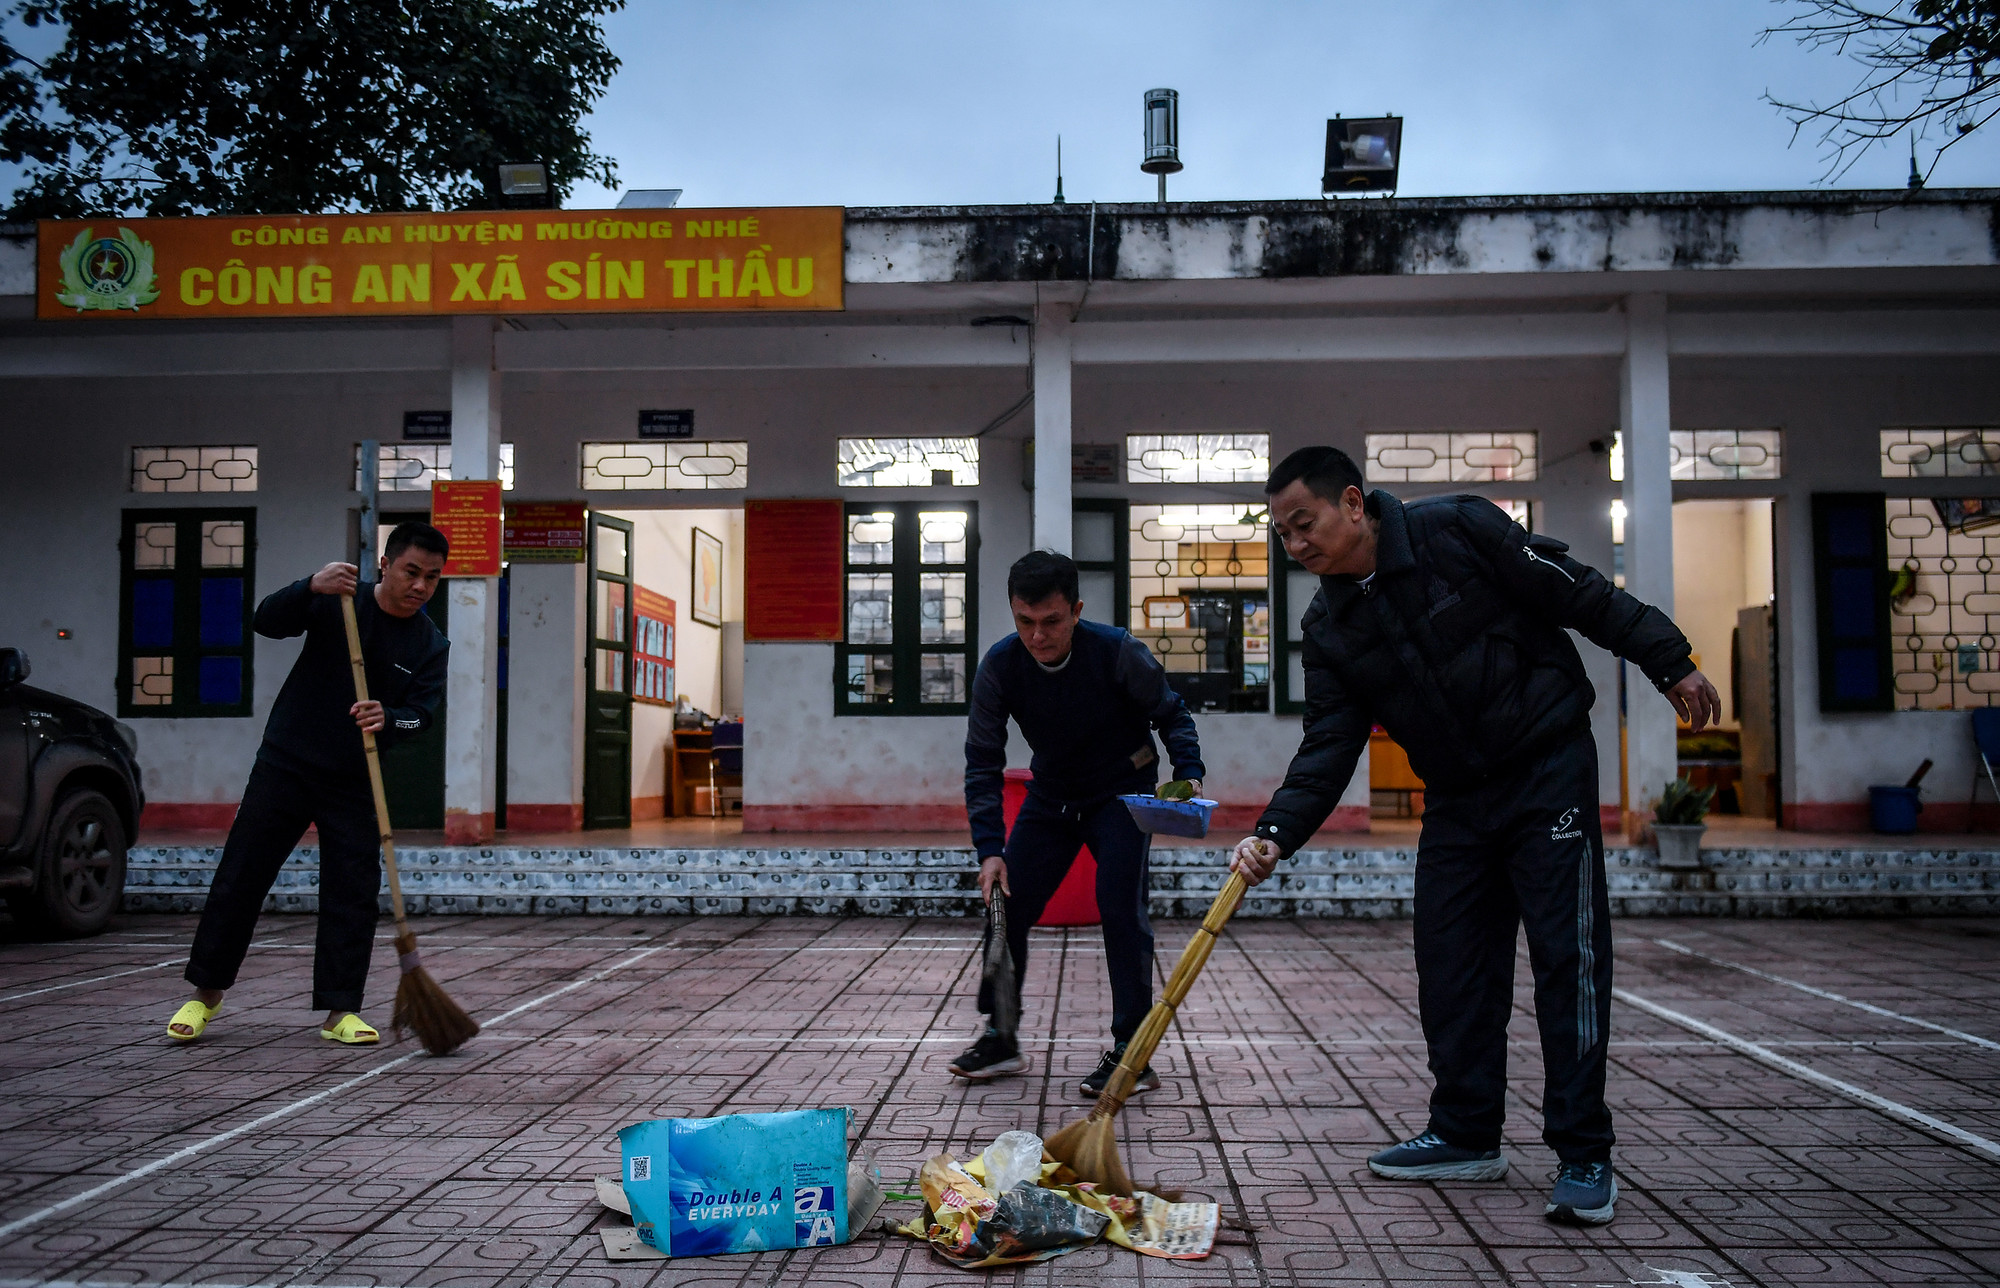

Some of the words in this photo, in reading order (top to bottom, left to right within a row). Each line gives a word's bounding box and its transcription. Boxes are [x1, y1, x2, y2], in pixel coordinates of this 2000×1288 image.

[231, 225, 329, 246] CÔNG
[341, 226, 392, 244] AN
[404, 221, 523, 245] HUYỆN
[536, 217, 673, 240] MƯỜNG
[686, 216, 760, 238] NHÉ
[179, 258, 333, 306] CÔNG
[352, 263, 430, 303] AN
[449, 254, 526, 302] XÃ
[546, 252, 645, 300] SÍN
[665, 244, 814, 299] THẦU
[690, 1188, 761, 1207] Double
[769, 1186, 783, 1202] A
[688, 1203, 781, 1221] EVERYDAY
